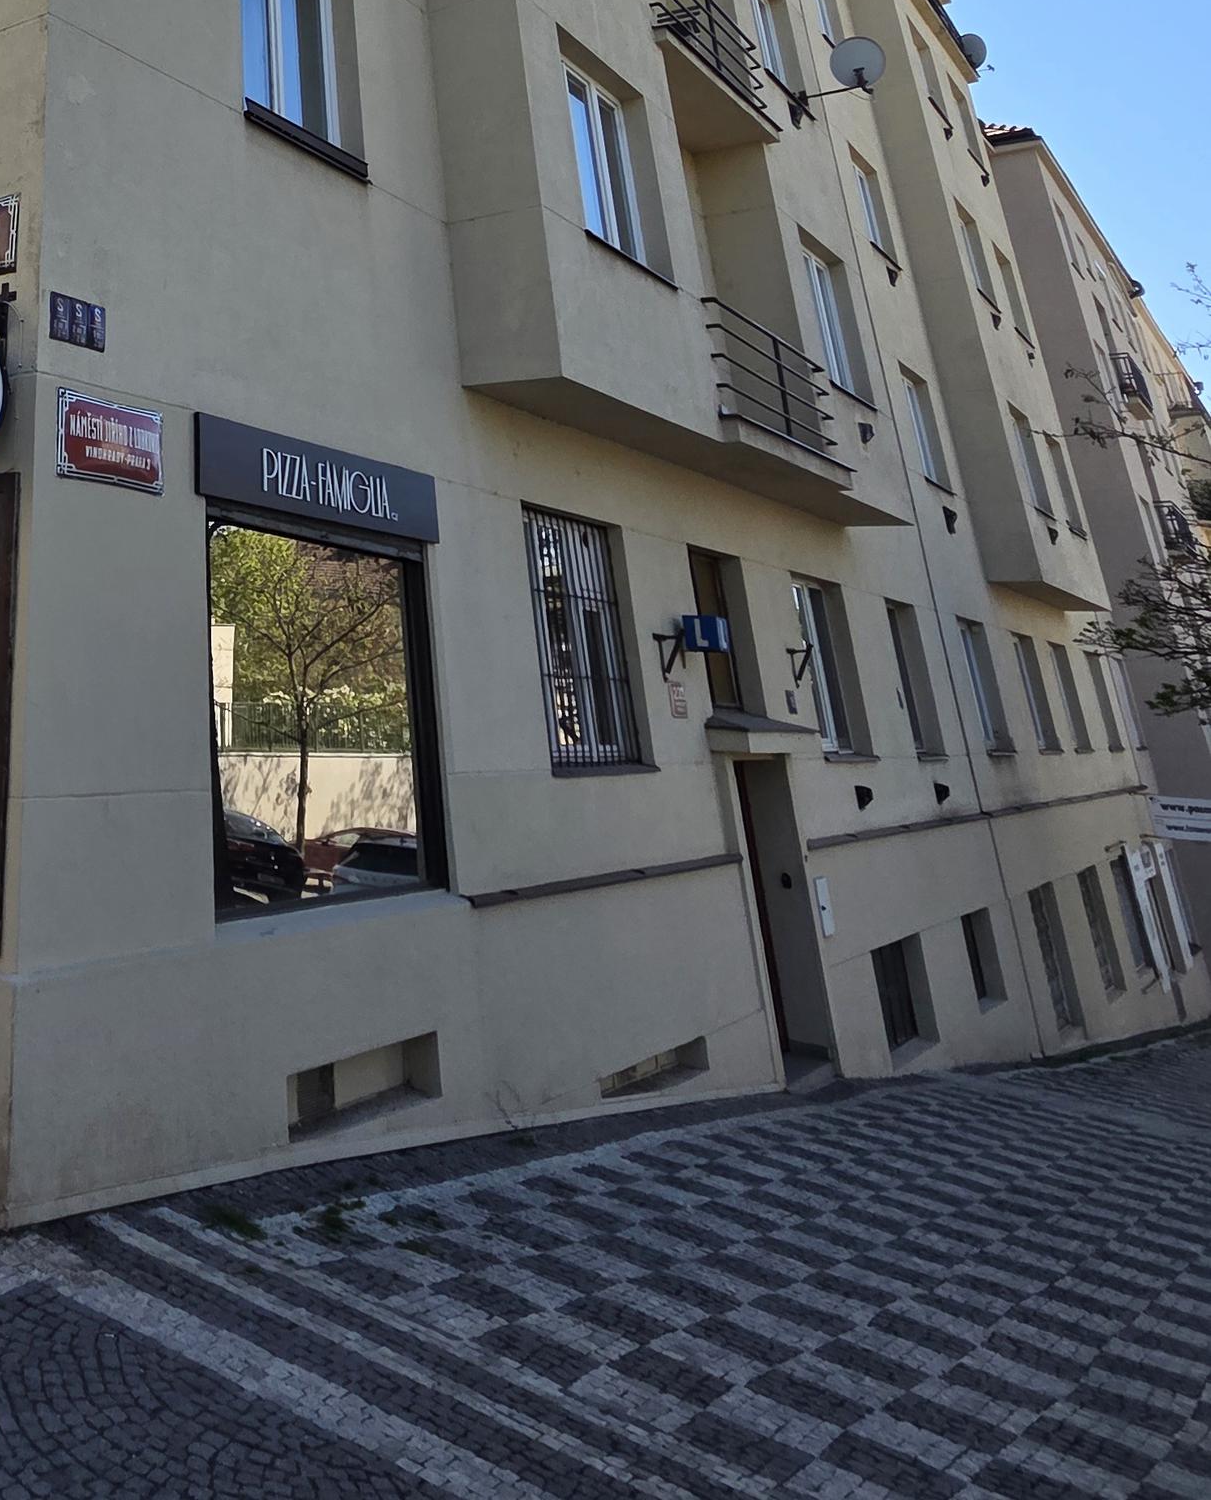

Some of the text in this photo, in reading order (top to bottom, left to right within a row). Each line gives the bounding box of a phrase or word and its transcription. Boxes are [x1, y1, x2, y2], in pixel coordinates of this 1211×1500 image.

[75, 303, 83, 318] S
[94, 307, 102, 322] S
[70, 411, 103, 441] NÁMĚSTÍ
[693, 618, 709, 647] L
